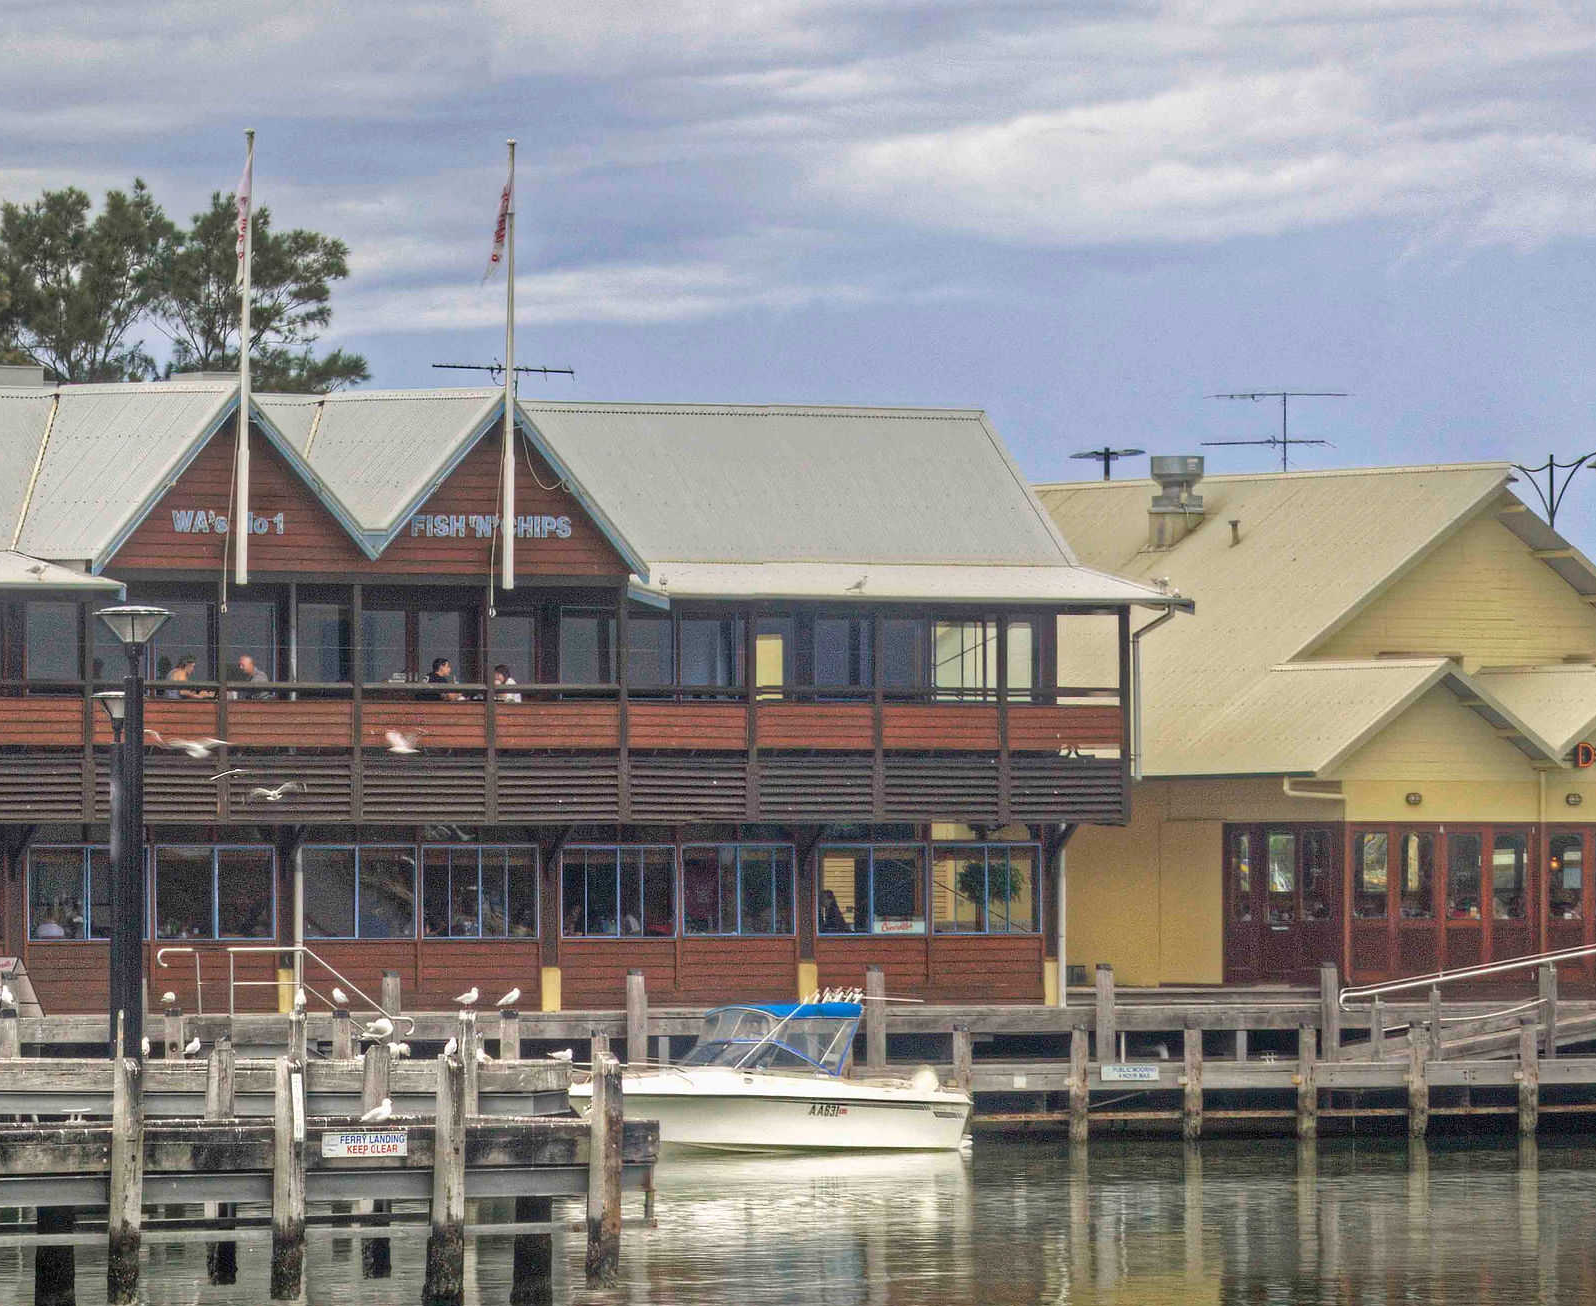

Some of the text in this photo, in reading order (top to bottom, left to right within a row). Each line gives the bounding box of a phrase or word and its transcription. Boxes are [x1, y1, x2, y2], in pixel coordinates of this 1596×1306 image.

[410, 514, 466, 538] FISH
[340, 1134, 405, 1144] FERRY LANDING
[347, 1144, 398, 1154] KEEP CLEAR
